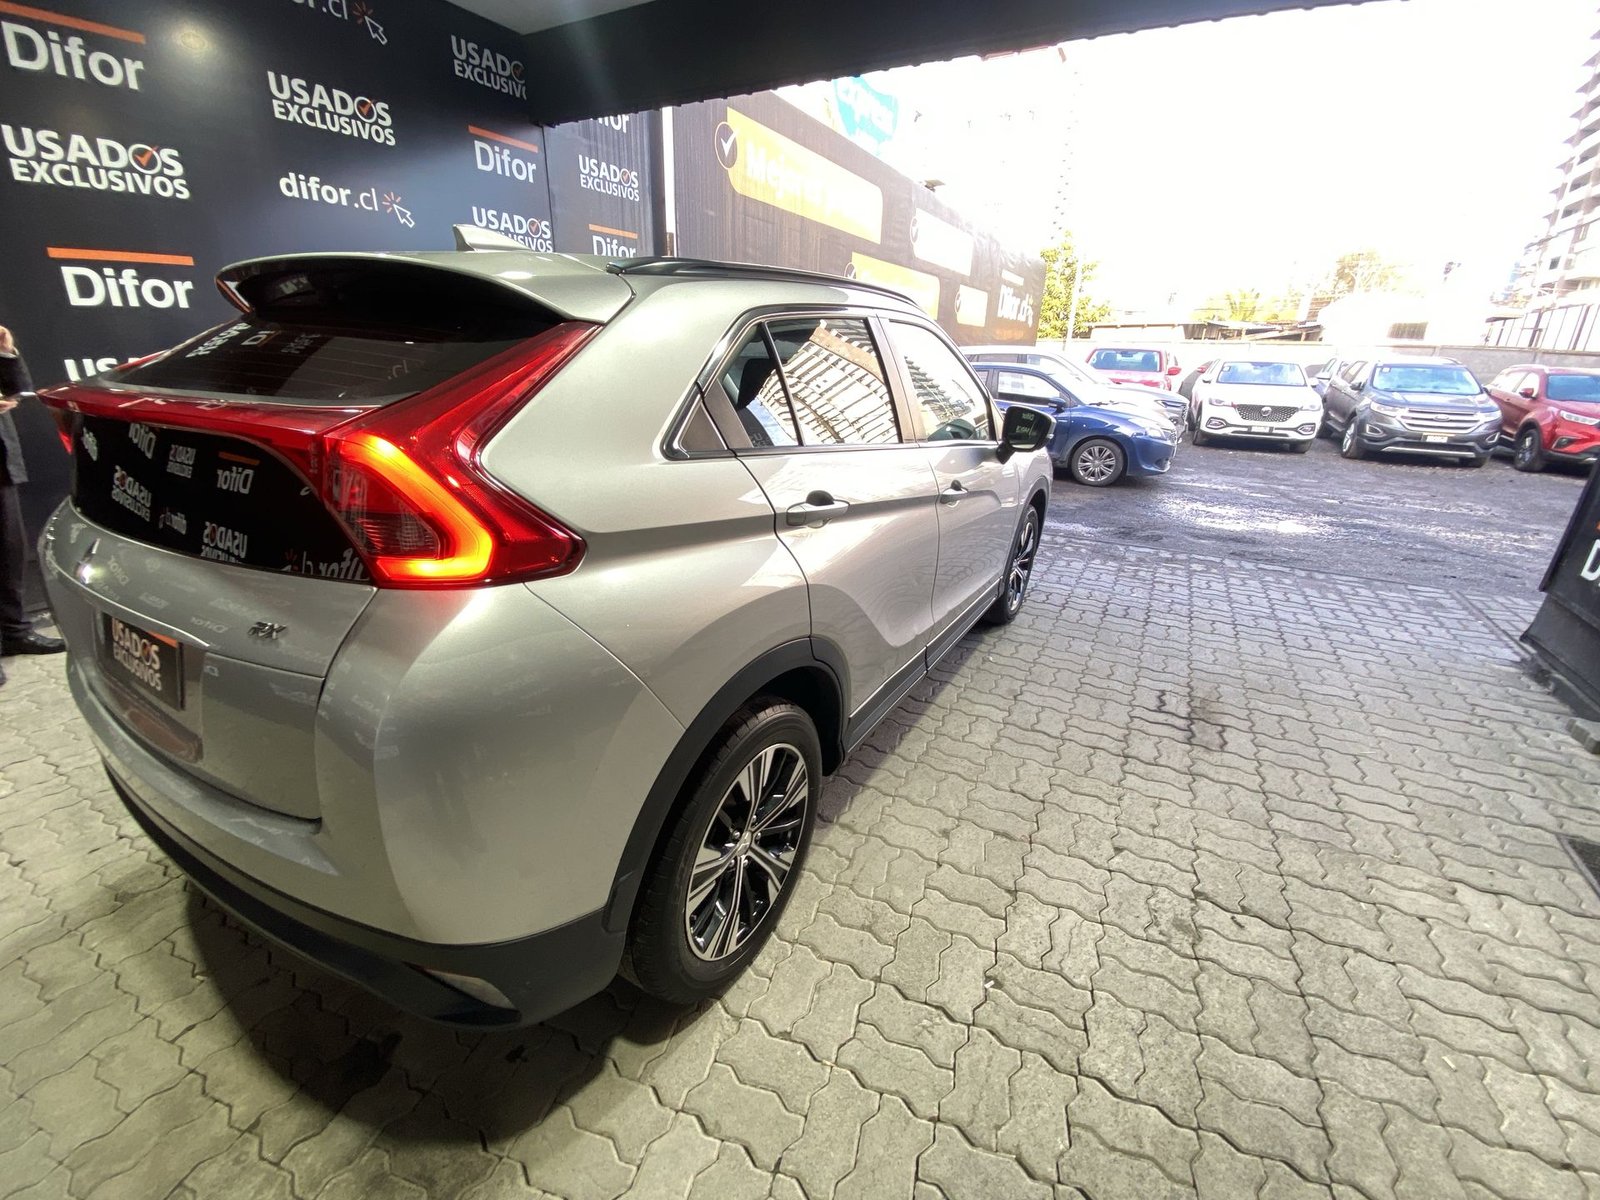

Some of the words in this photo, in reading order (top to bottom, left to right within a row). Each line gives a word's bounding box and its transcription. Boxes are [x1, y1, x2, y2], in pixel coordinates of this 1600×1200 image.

[1, 21, 145, 91] Difor
[267, 71, 393, 127] USADOS
[272, 98, 396, 146] EXCLUSIVOS
[0, 124, 185, 178] USADOS
[474, 140, 537, 184] Difor
[578, 154, 639, 189] USADOS
[9, 157, 191, 200] EXCLUSIVOS
[279, 172, 379, 212] difor.cl
[580, 174, 640, 202] EXCLUSIVOS
[472, 206, 551, 240] USADOS
[592, 235, 637, 258] Difor
[60, 265, 195, 309] Difor
